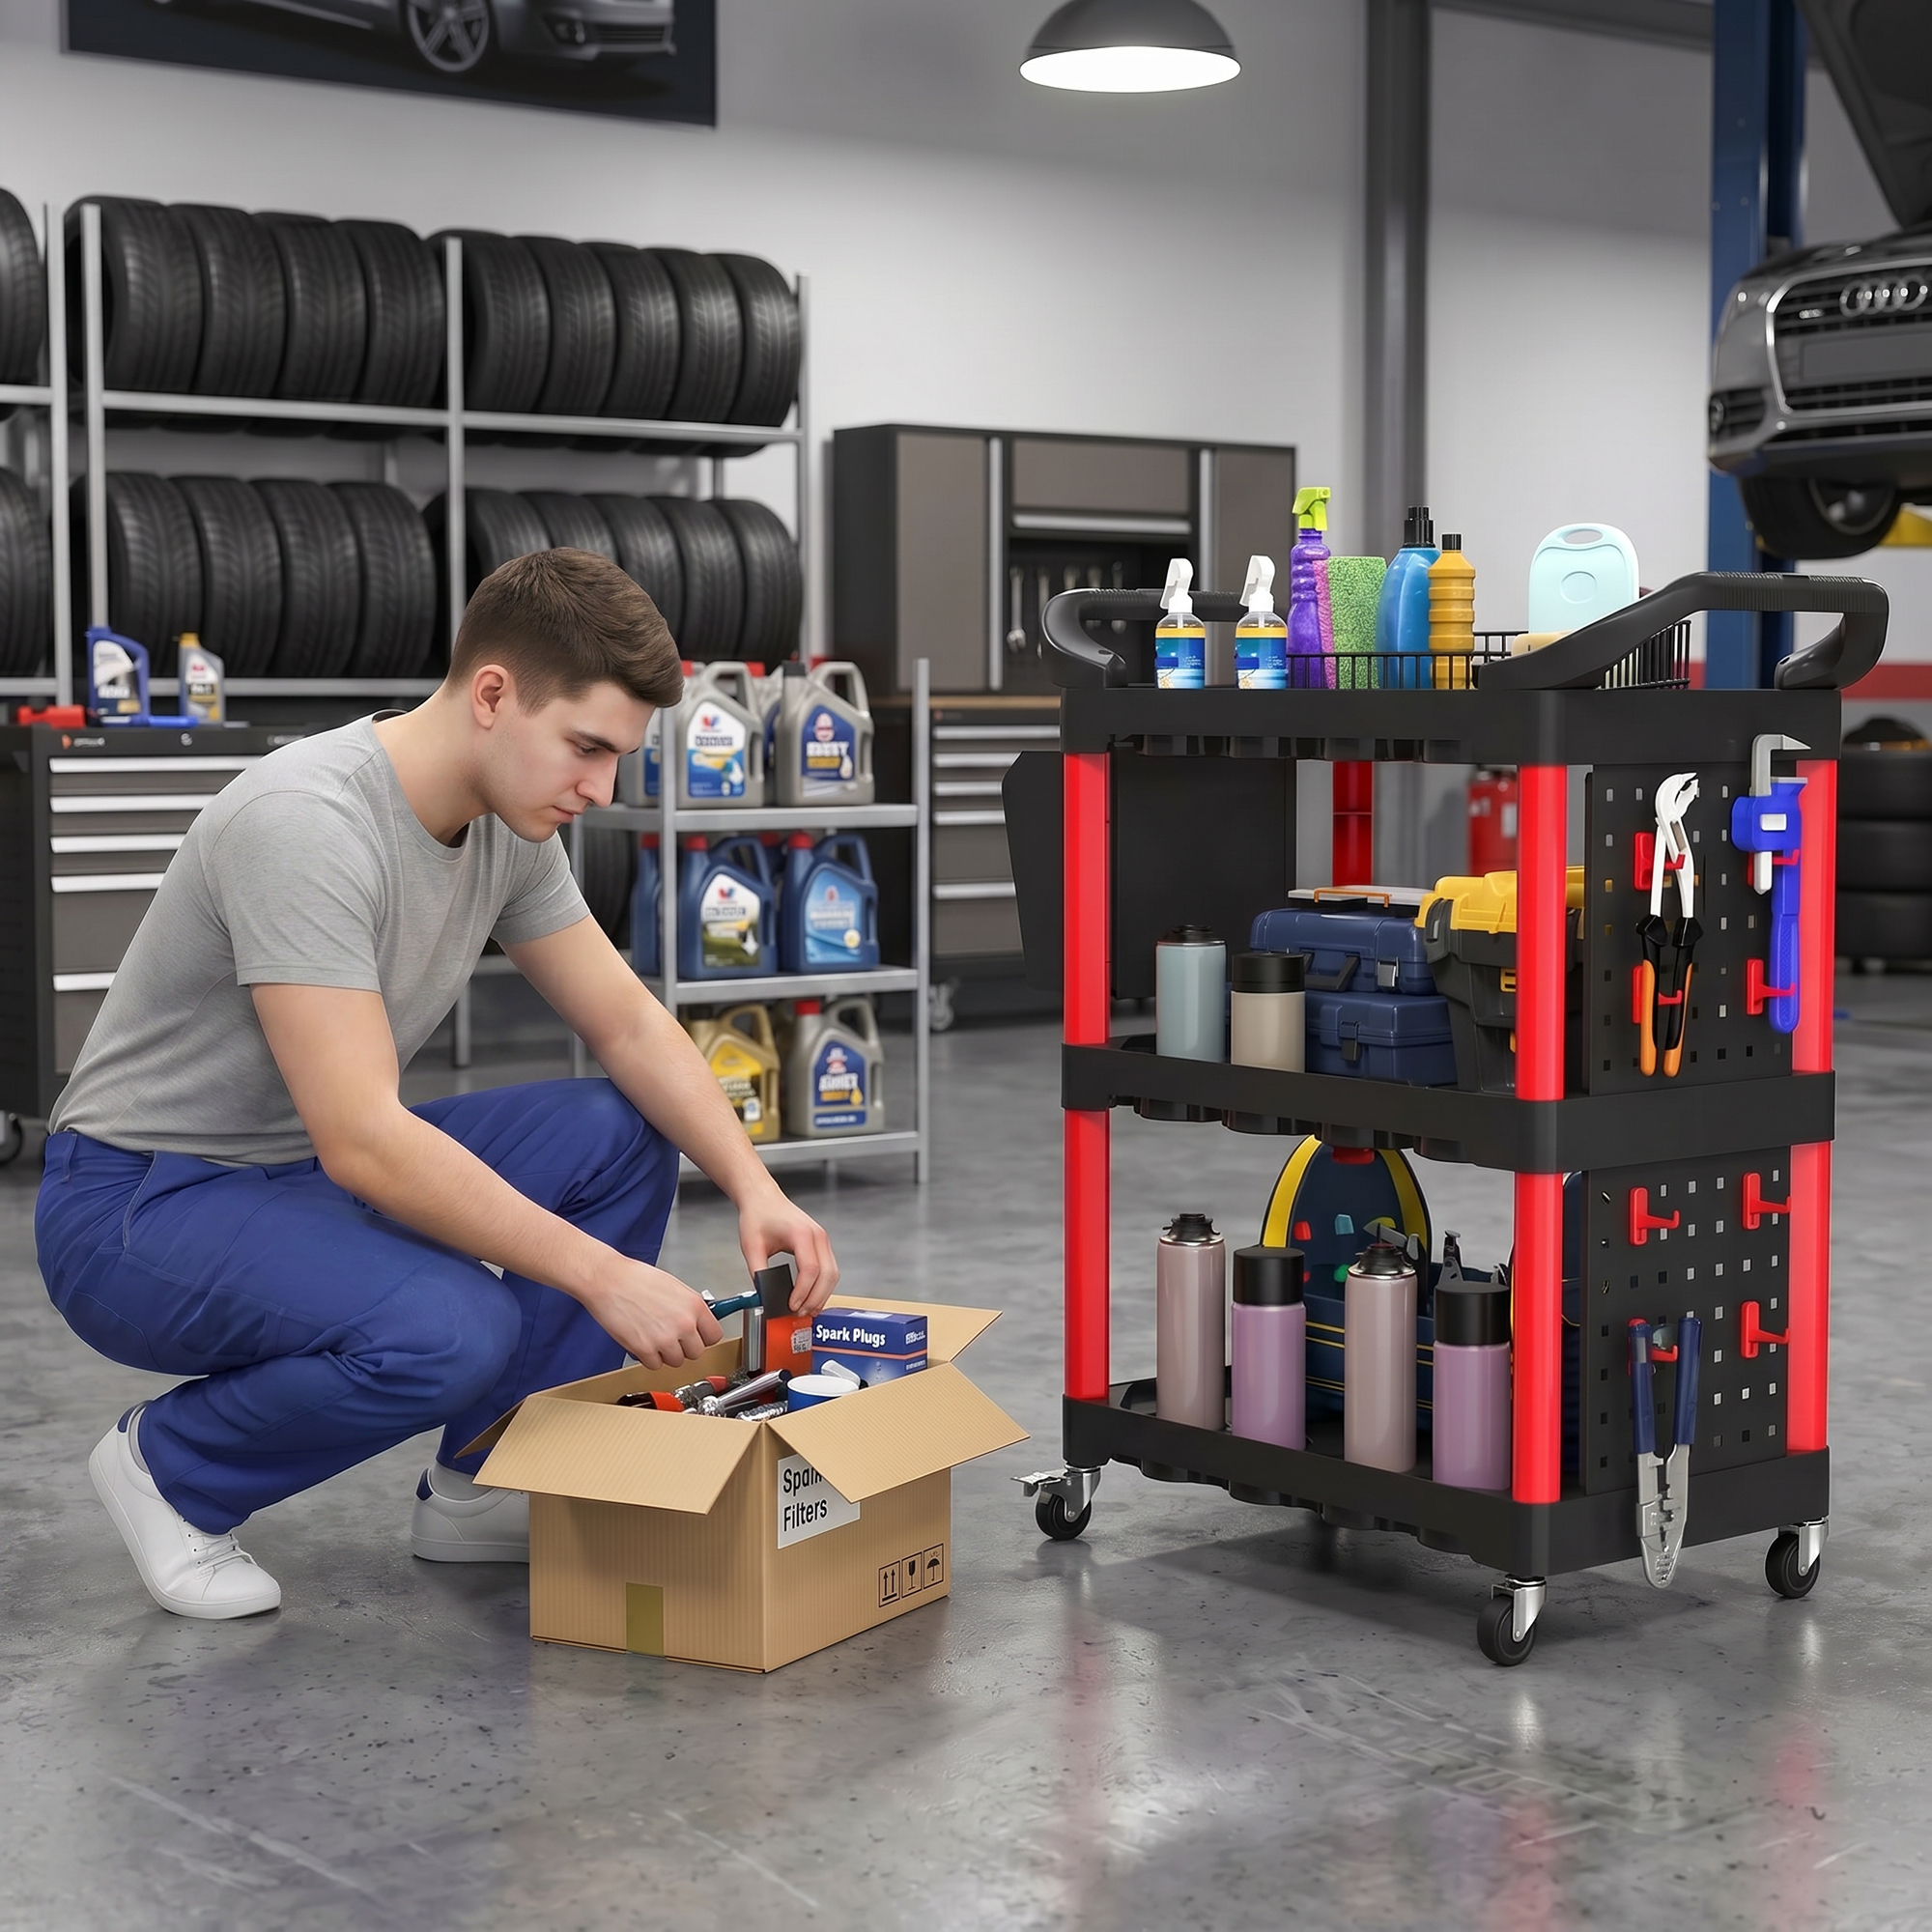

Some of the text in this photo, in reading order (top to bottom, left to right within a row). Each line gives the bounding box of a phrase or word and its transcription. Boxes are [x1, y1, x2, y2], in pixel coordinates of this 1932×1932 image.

[816, 1324, 850, 1342] Spark
[853, 1328, 886, 1348] Plugs
[783, 1499, 827, 1532] Filters
